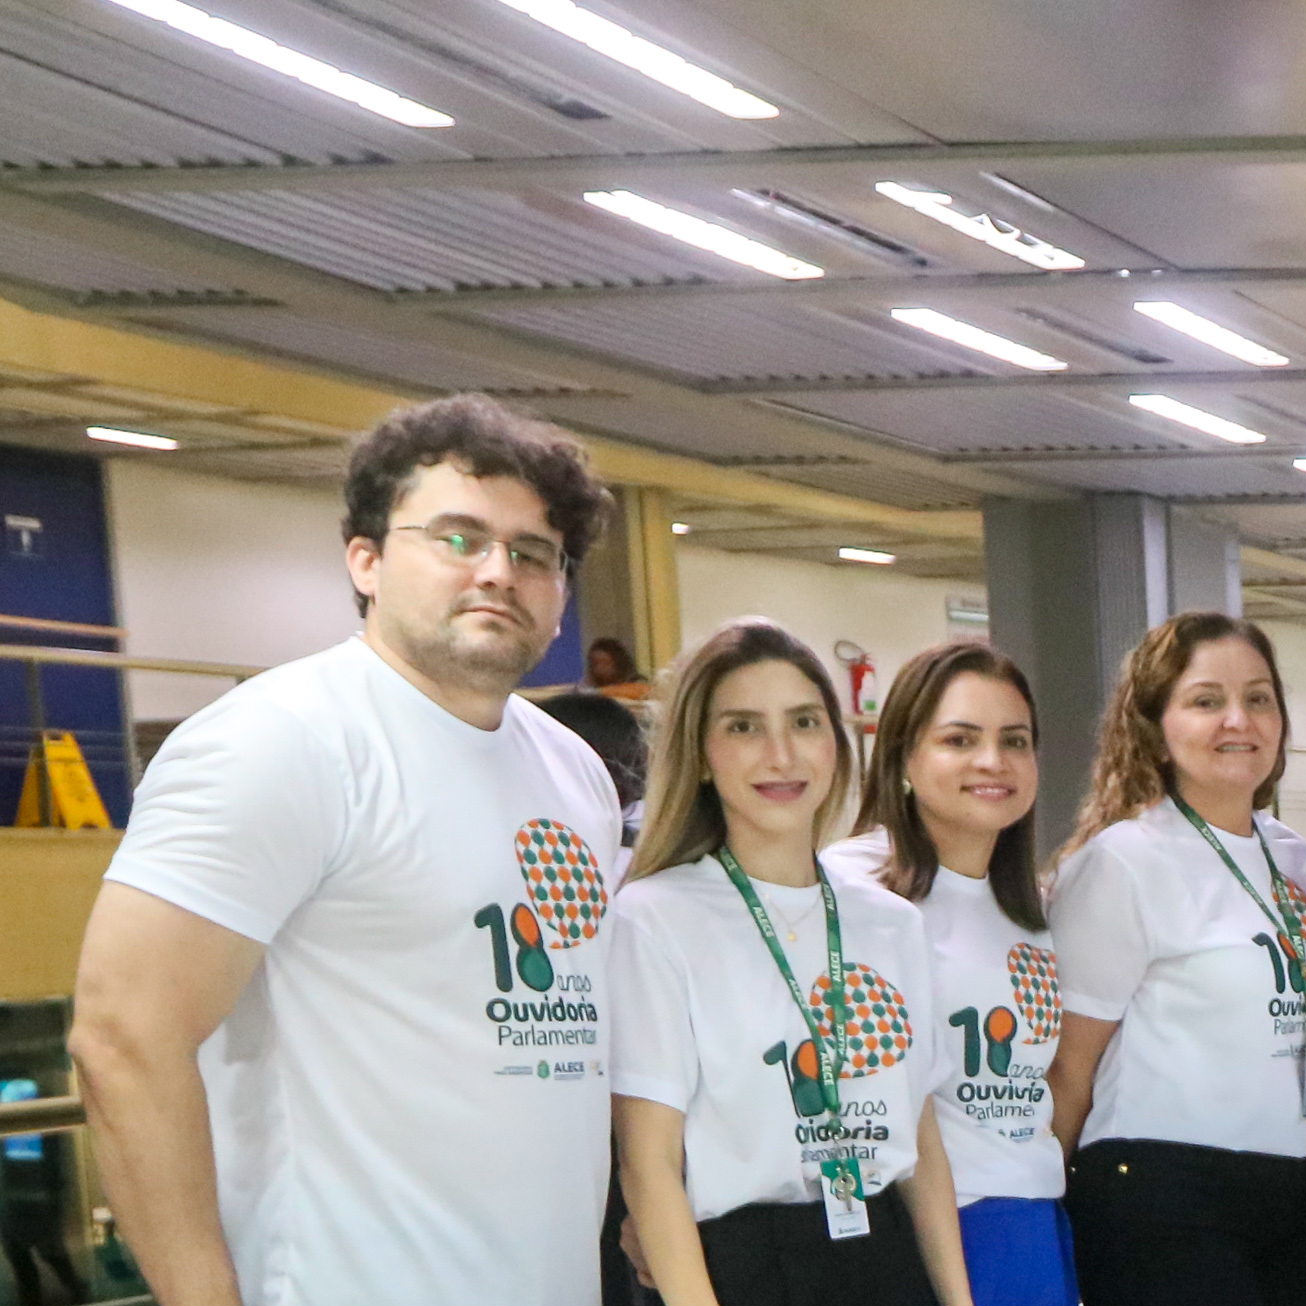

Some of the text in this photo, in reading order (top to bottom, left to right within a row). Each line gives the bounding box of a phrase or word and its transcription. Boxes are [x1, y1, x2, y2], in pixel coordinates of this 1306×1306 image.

[752, 906, 776, 938] ALECE
[474, 902, 554, 993] 18
[829, 949, 842, 983] ALECE
[486, 994, 598, 1023] Ouvidoria
[949, 1005, 1018, 1078] 18
[820, 1051, 835, 1087] ALECE
